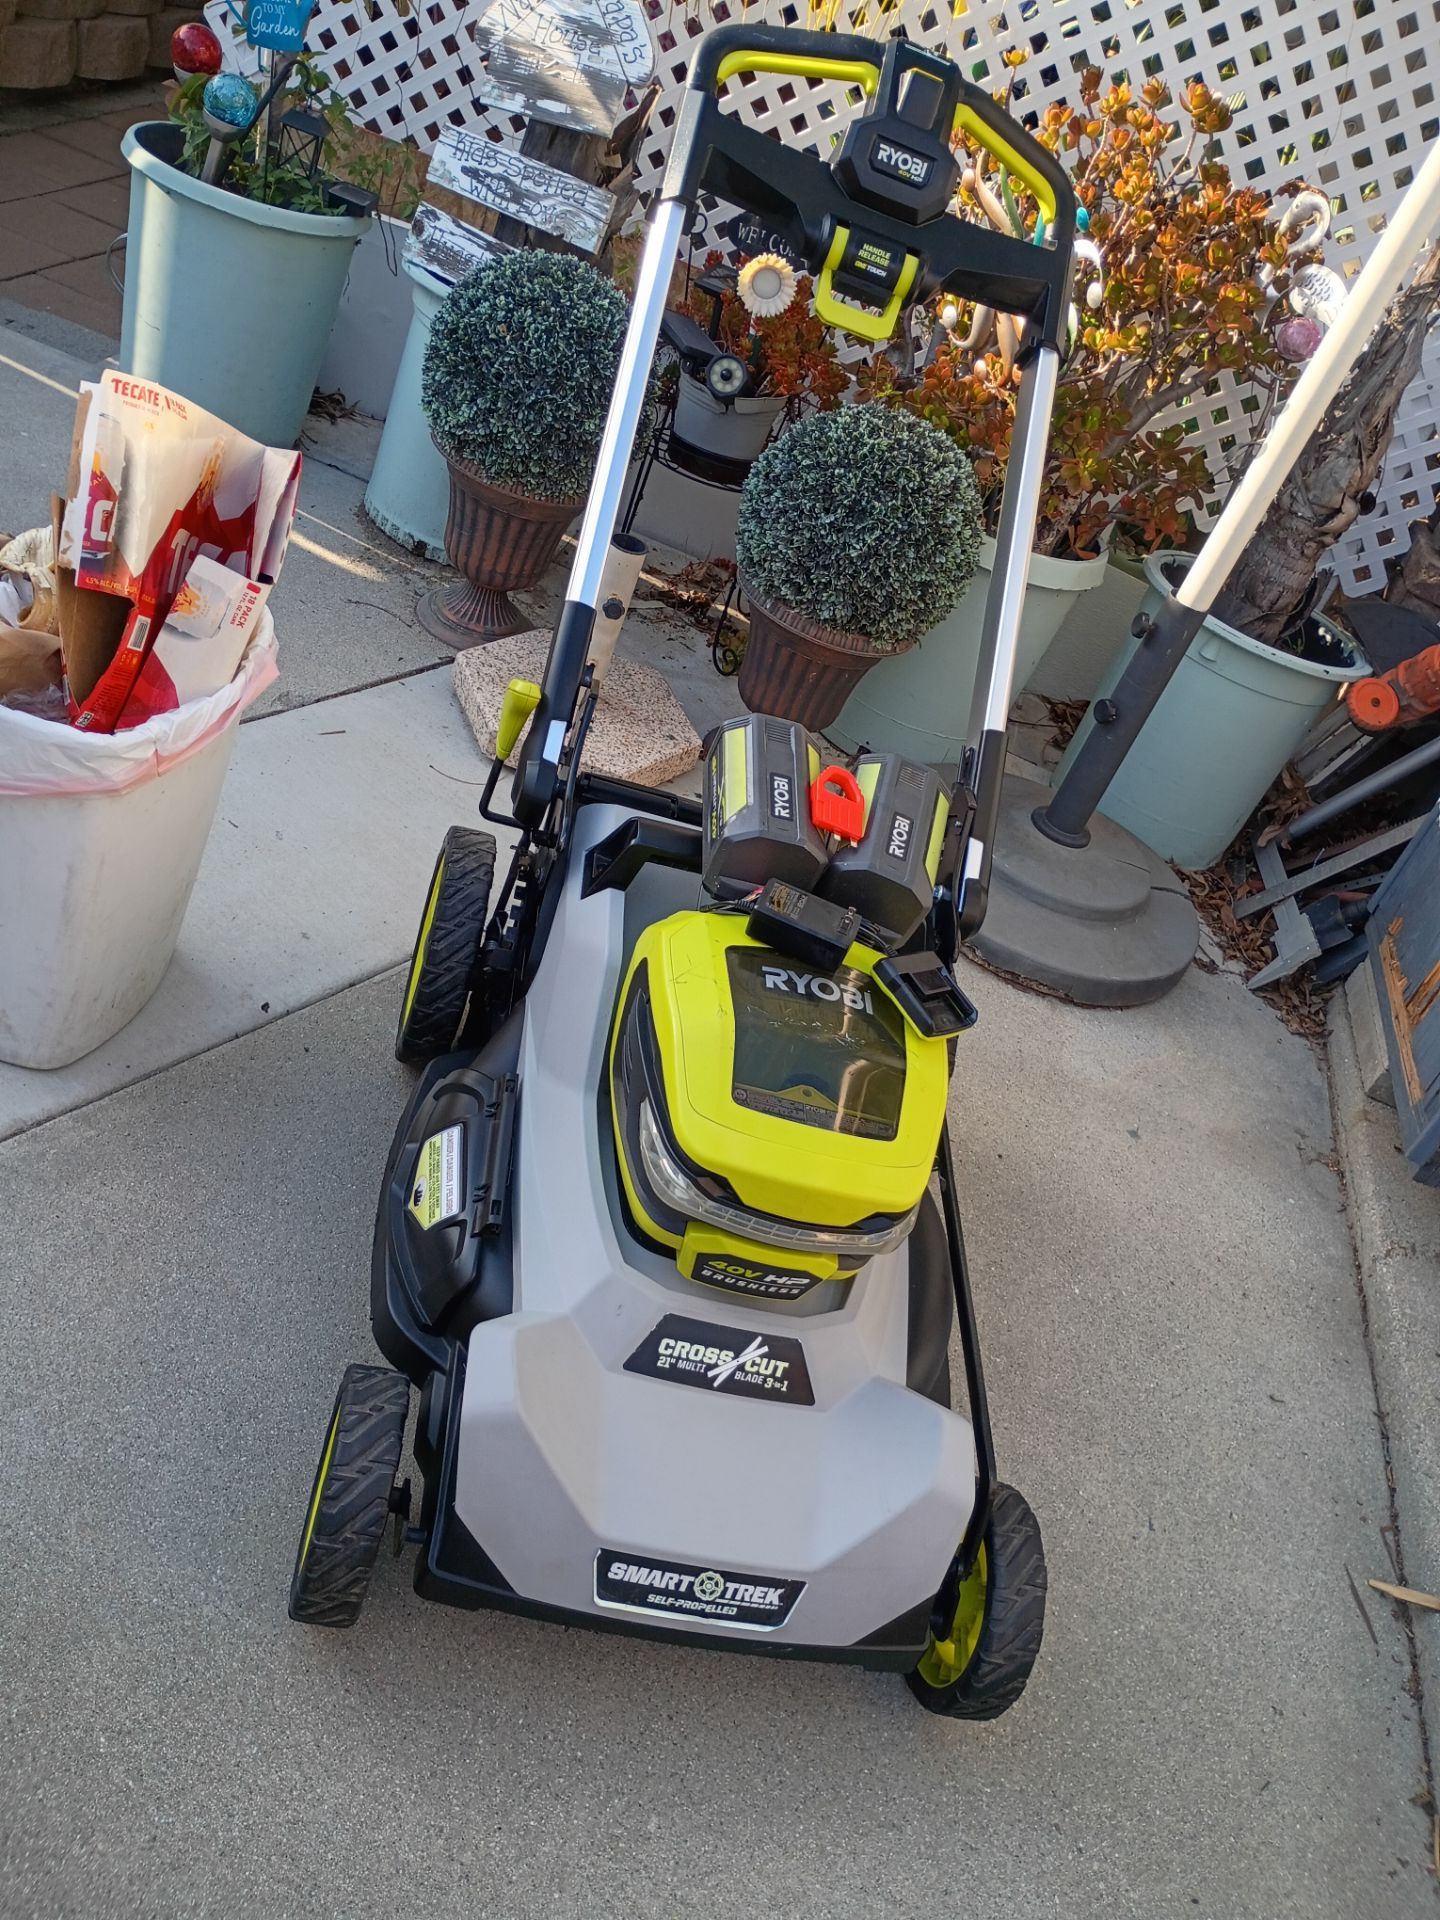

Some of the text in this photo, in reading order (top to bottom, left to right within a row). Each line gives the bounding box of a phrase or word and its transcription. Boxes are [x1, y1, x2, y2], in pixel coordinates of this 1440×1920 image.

[250, 6, 300, 37] Garden
[262, 3, 273, 14] TO
[532, 13, 601, 57] House
[603, 0, 647, 64] apa's
[452, 131, 590, 207] Kids Spoiled
[877, 143, 928, 178] RYOBI
[858, 250, 890, 268] RELEASE
[862, 243, 892, 258] HANDLE
[854, 261, 888, 278] ONE TOUCH
[111, 378, 160, 407] TECATE
[236, 595, 257, 629] 18 PACK
[773, 775, 790, 818] RYOBI
[889, 815, 911, 858] RYOBI
[761, 965, 874, 1016] RYOBI
[701, 1269, 800, 1294] BRUSHLESS
[708, 1261, 811, 1285] 40V HP
[657, 1356, 676, 1369] 21"
[677, 1360, 707, 1374] MULTI
[734, 1371, 764, 1385] BLADE
[658, 1338, 789, 1378] CROSS CUT
[607, 1562, 785, 1605] SMART TREK
[647, 1593, 738, 1616] SELF-PROPELLED
